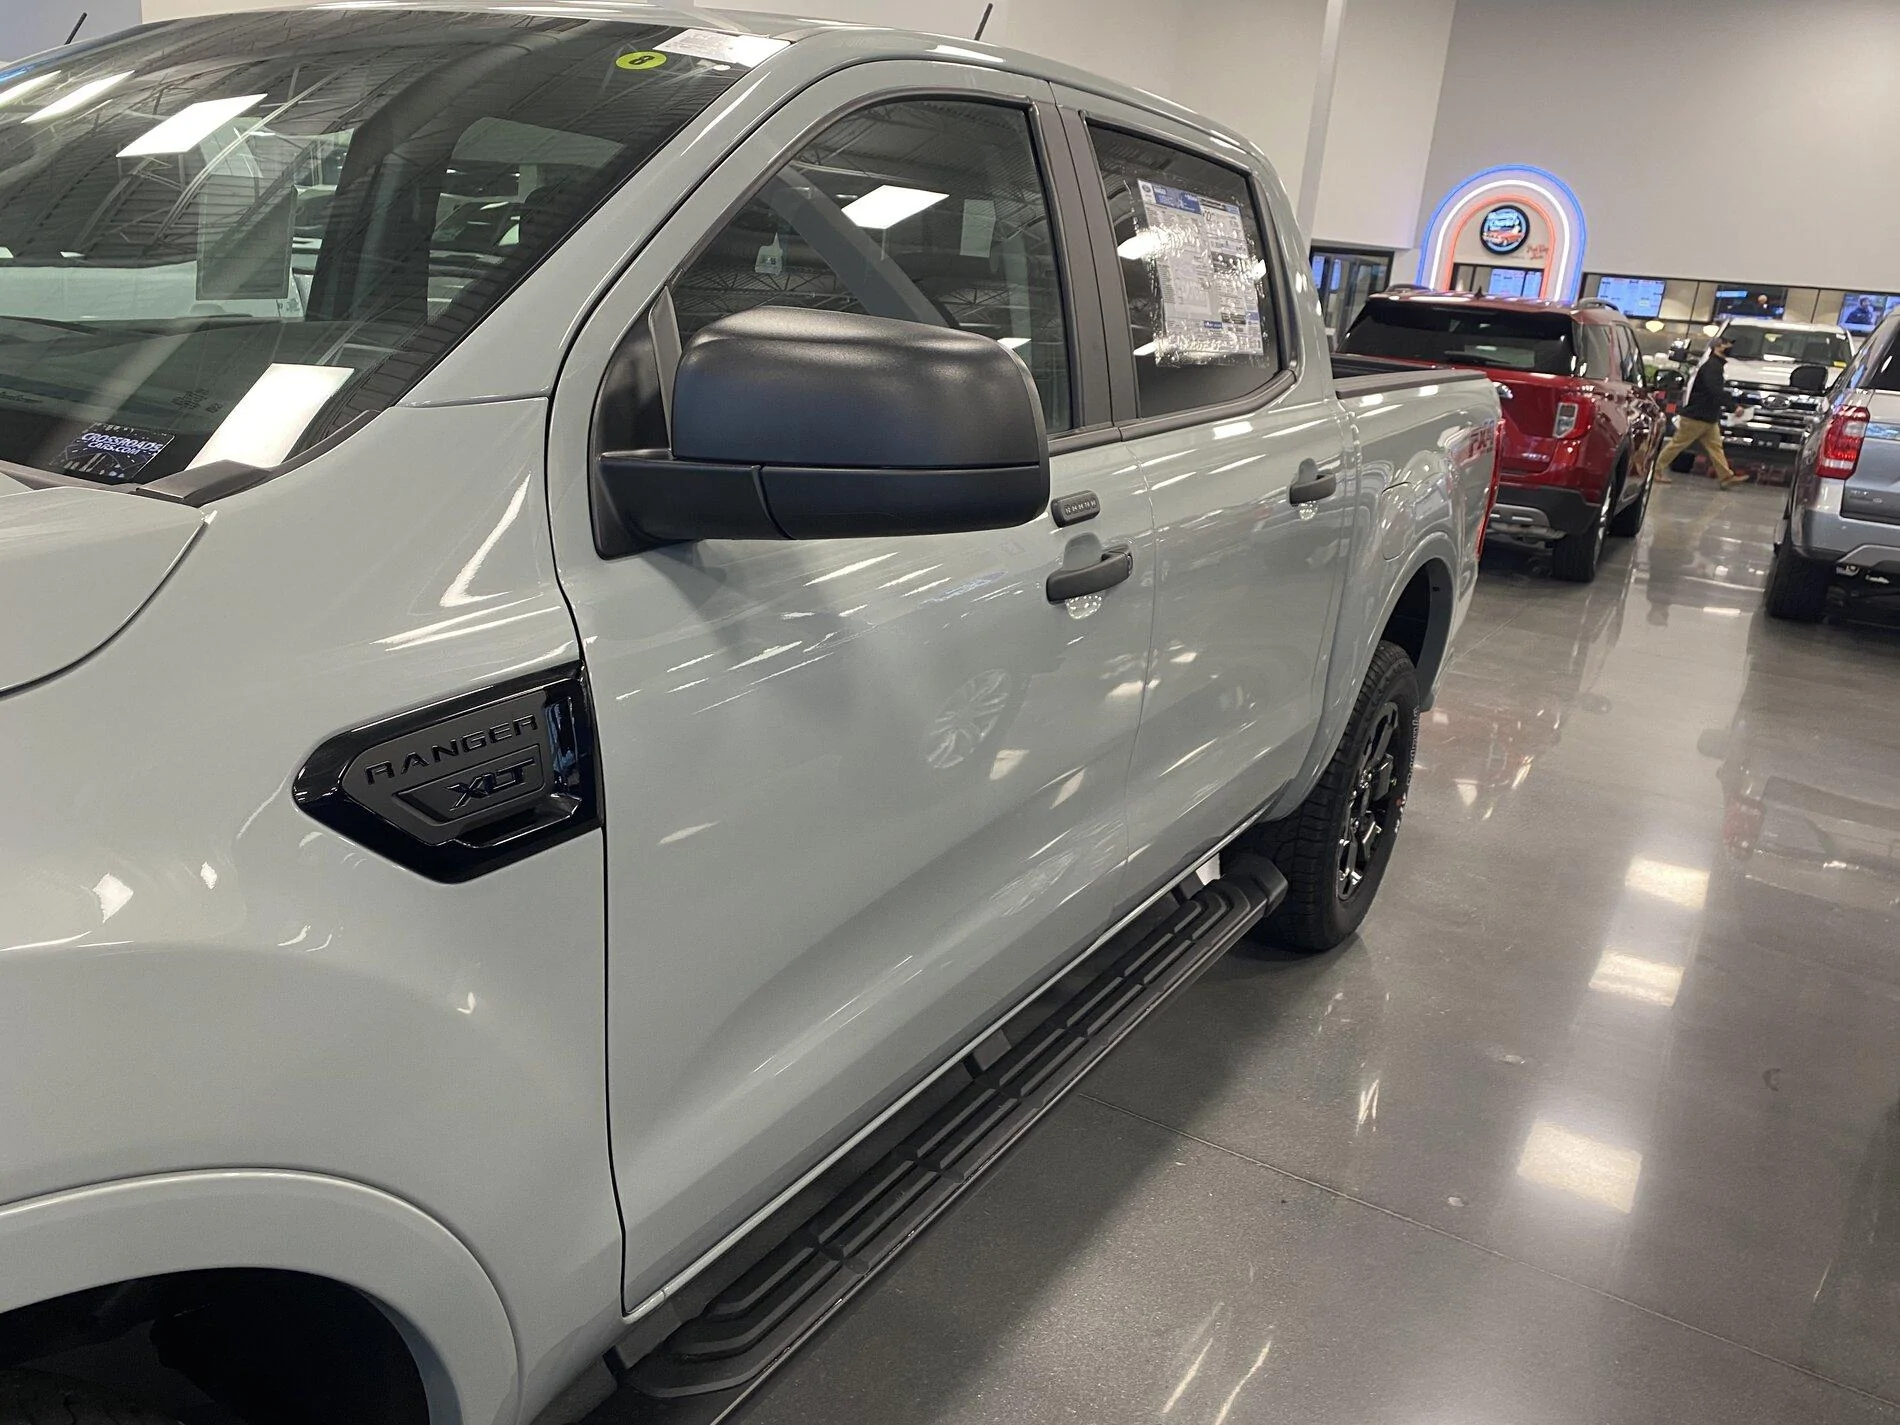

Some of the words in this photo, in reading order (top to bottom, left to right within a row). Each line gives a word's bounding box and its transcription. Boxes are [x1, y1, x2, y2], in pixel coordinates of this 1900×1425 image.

[81, 432, 163, 452] CROSSROADS
[87, 442, 141, 455] CARS.COM
[364, 713, 539, 785] RANGER
[443, 758, 536, 812] XLT
